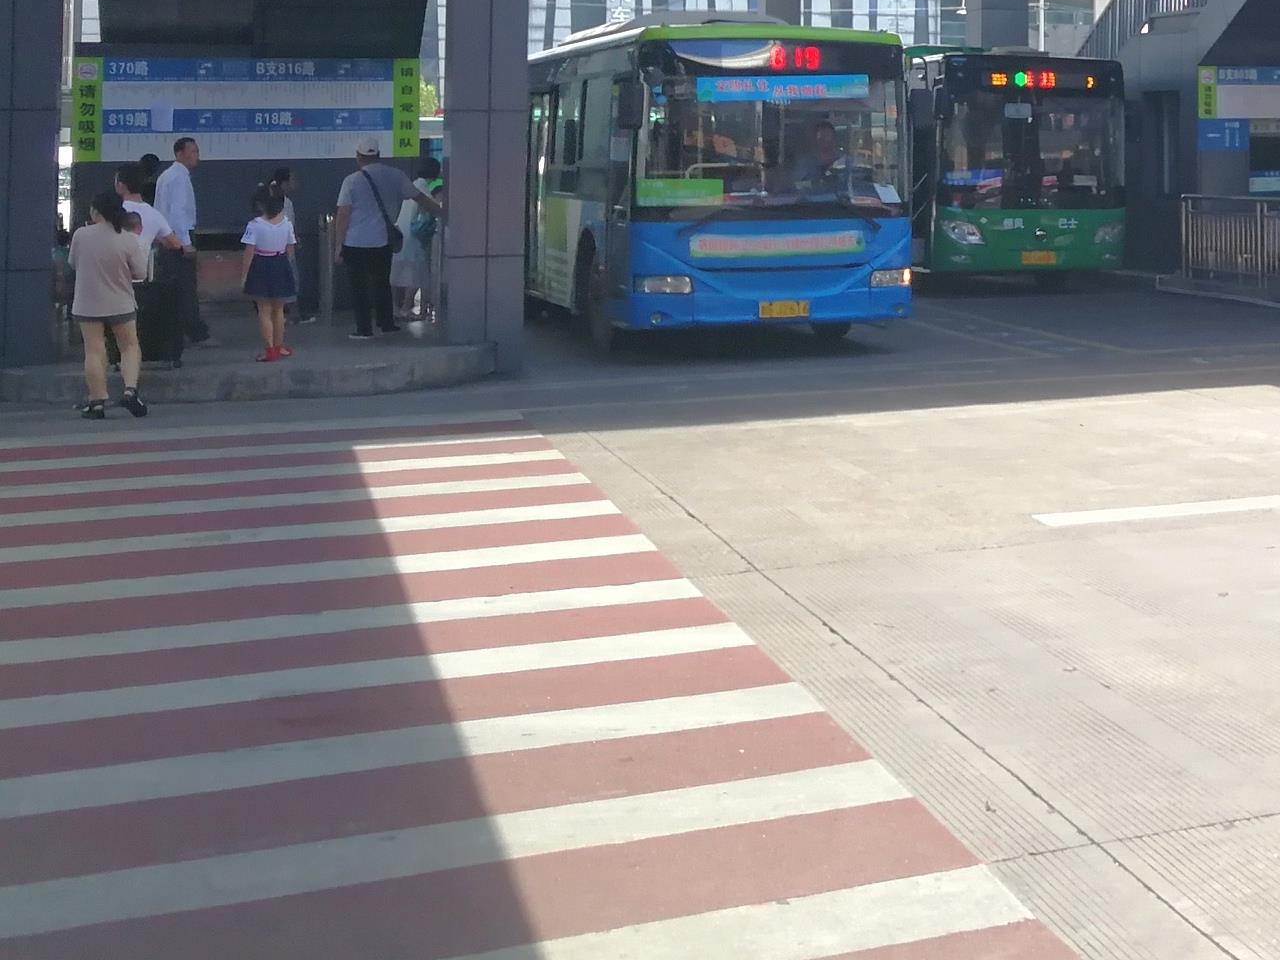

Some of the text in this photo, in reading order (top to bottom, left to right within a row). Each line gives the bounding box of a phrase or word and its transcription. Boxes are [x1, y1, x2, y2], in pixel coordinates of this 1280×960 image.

[109, 61, 149, 76] 370路
[79, 84, 96, 152] 请勿吸烟
[108, 111, 148, 127] 819路
